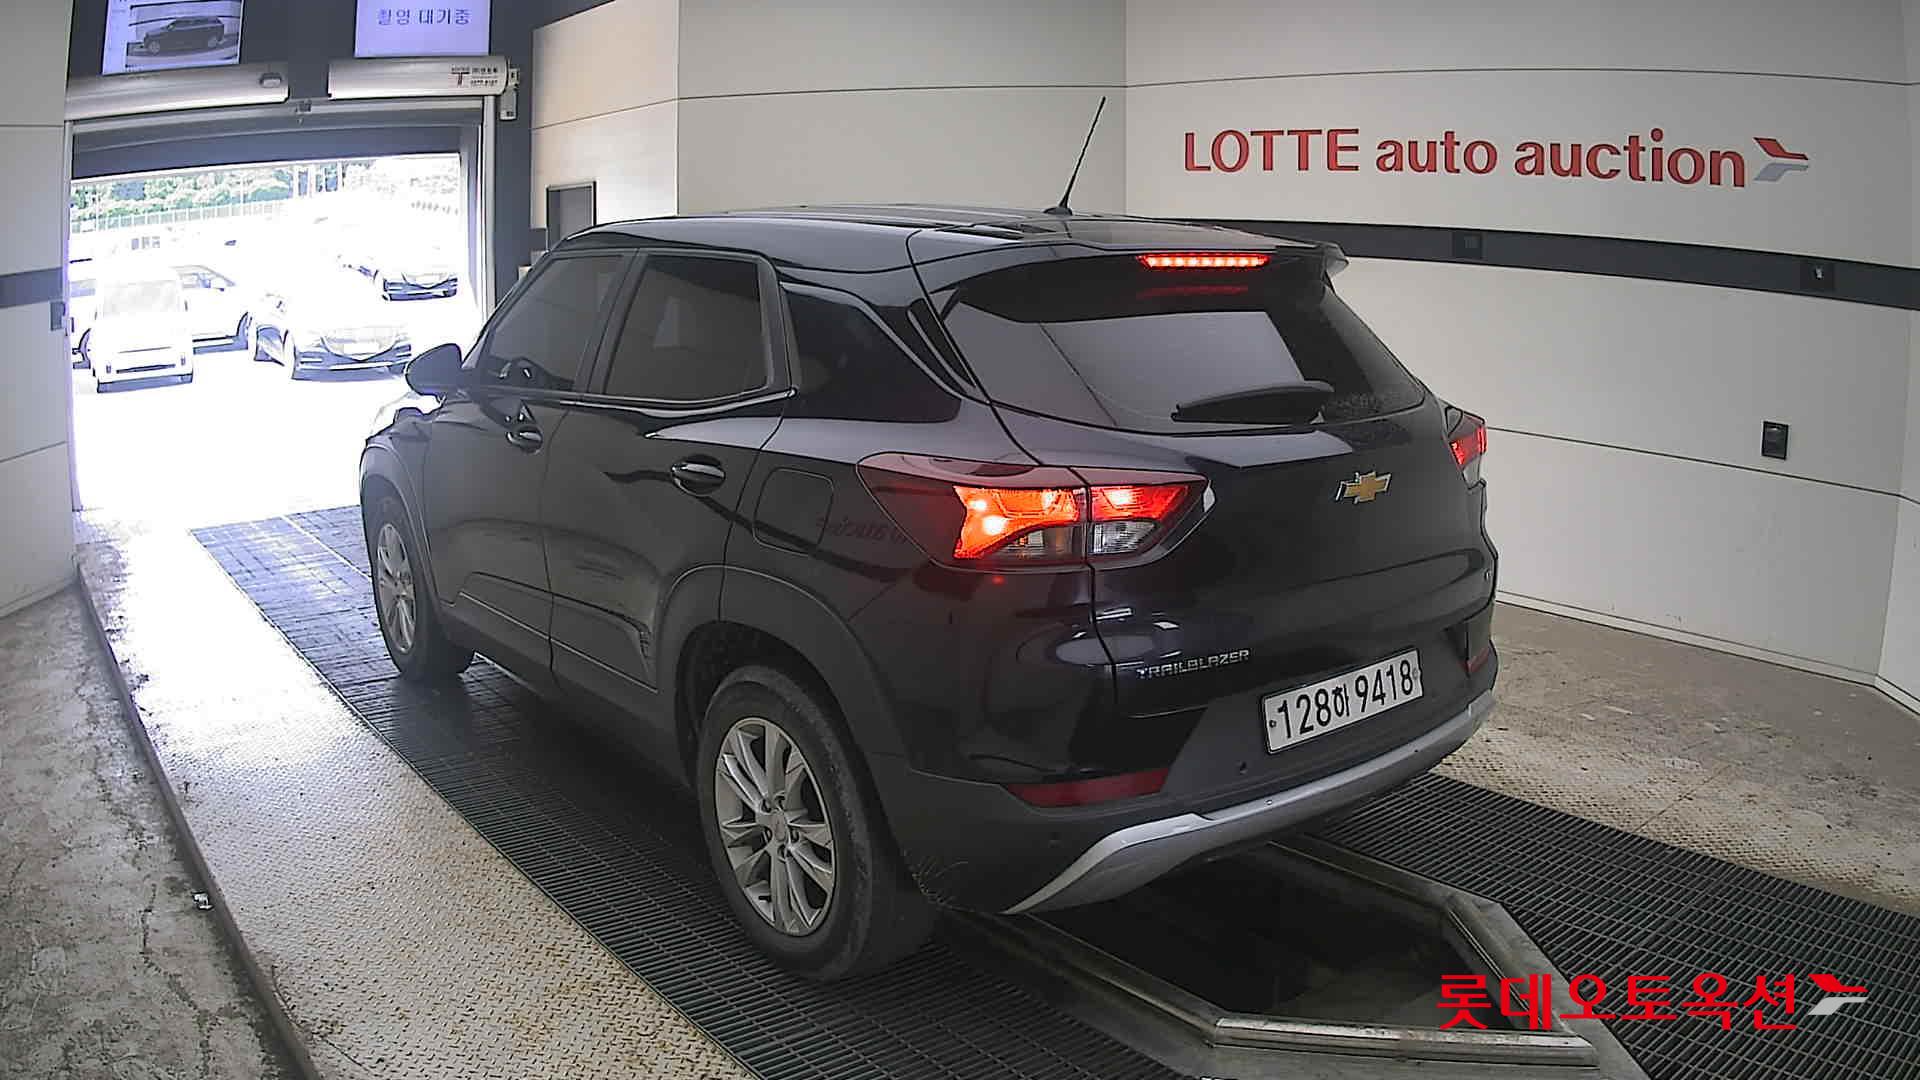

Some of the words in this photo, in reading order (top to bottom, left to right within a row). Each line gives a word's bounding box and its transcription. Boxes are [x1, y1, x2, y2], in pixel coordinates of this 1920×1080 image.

[419, 8, 471, 26] 대기중
[1184, 128, 1359, 172] LOTTE
[1376, 131, 1498, 175] auto
[1514, 128, 1745, 188] auction
[1136, 650, 1249, 679] TRAILBLAZER
[1277, 683, 1350, 739] 128하
[1354, 659, 1414, 713] 9418
